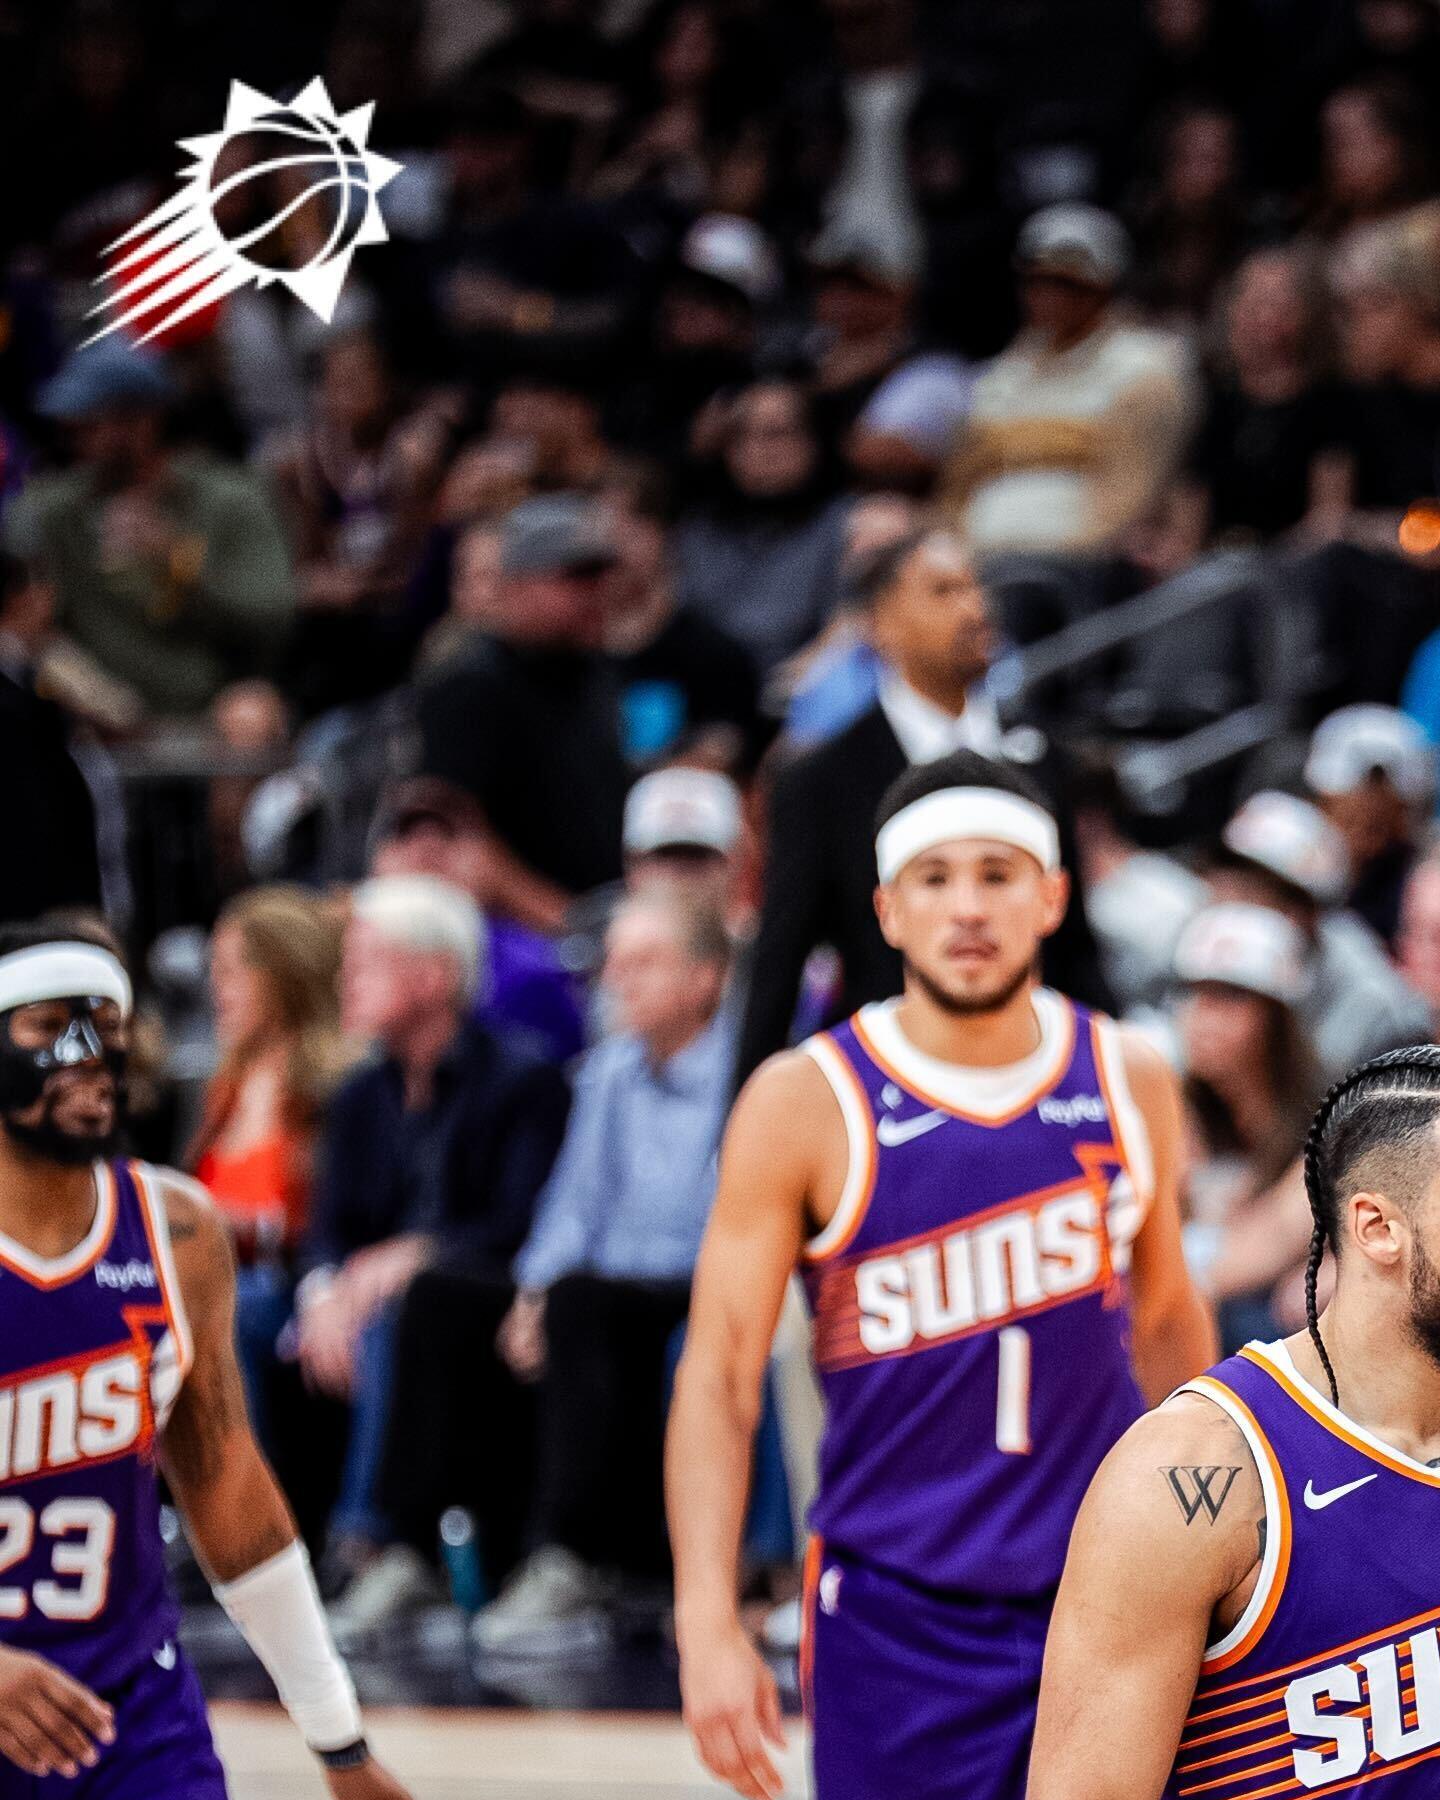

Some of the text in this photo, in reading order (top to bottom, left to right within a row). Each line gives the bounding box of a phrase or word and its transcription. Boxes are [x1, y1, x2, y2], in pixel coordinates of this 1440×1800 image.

[855, 1190, 1098, 1355] SUNS
[0, 1354, 142, 1478] NS
[996, 1325, 1032, 1456] 1
[1157, 1465, 1243, 1526] W
